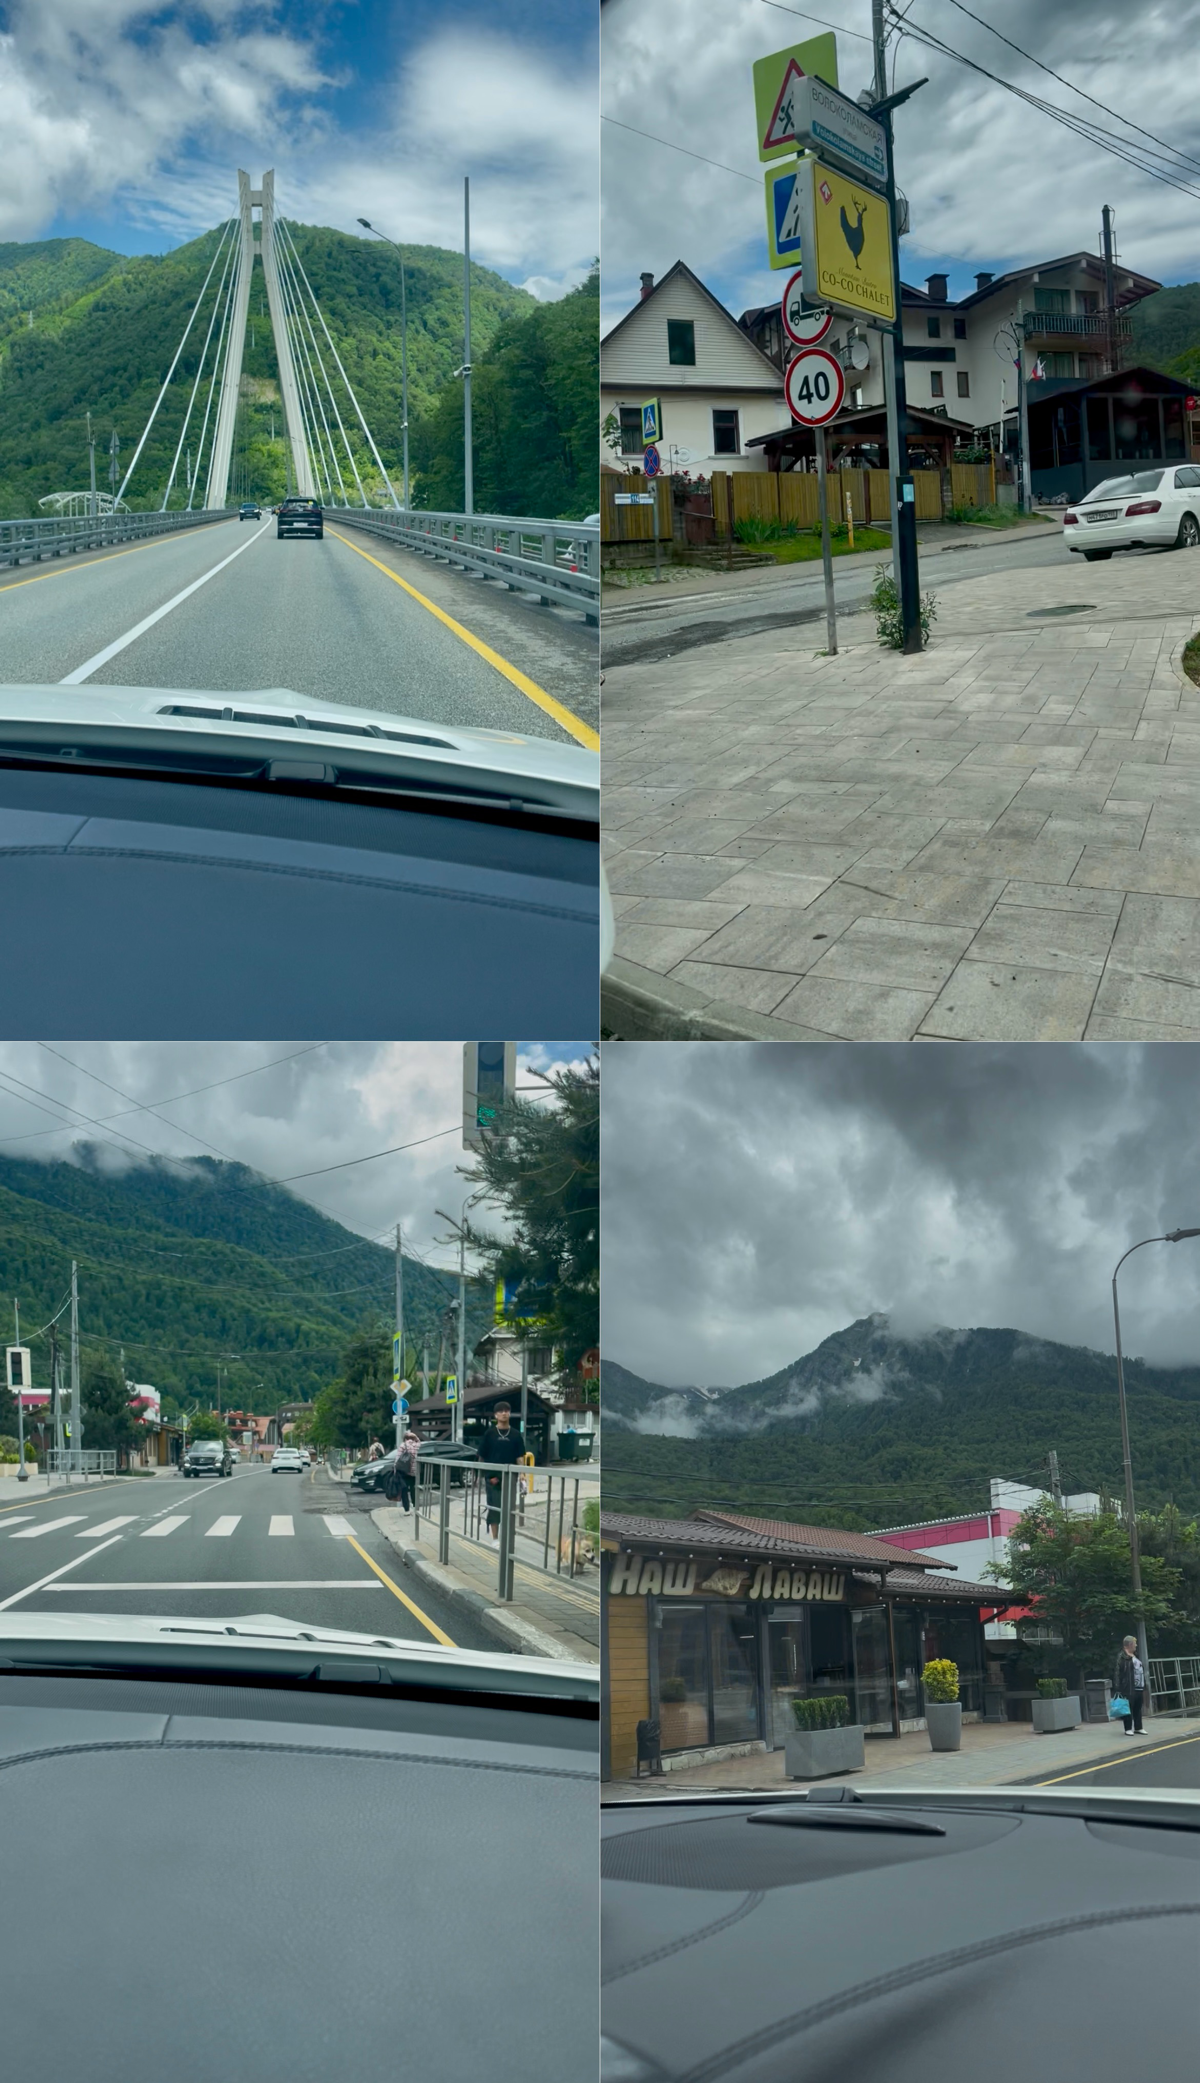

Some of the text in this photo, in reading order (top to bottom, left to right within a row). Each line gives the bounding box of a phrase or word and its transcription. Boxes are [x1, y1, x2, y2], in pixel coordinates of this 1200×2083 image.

[812, 87, 884, 144] ВОЛОКОЛАМСКАЯ
[822, 270, 890, 307] CO-CO CHALET
[798, 371, 830, 405] 40
